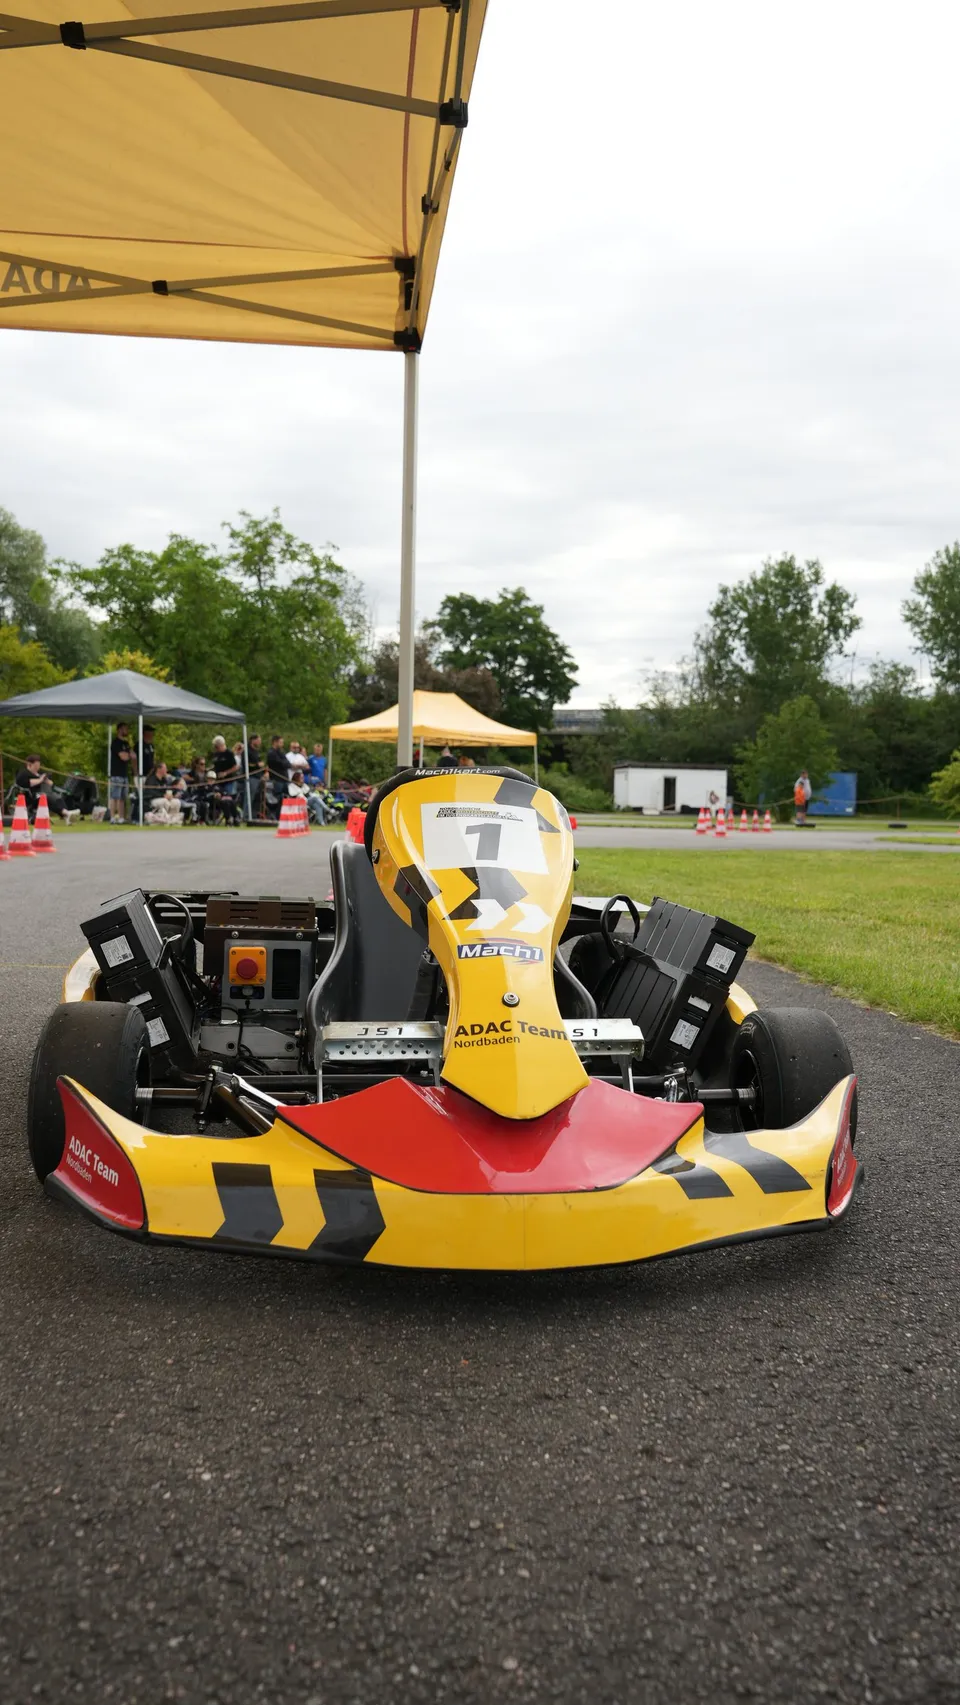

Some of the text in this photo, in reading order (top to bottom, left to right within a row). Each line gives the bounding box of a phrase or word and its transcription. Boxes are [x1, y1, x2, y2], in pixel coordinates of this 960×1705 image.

[465, 823, 502, 860] 1
[460, 944, 541, 960] Mach1
[454, 1020, 568, 1040] ADAC Team
[454, 1035, 520, 1048] Nordbaden
[69, 1135, 119, 1187] ADAC Team
